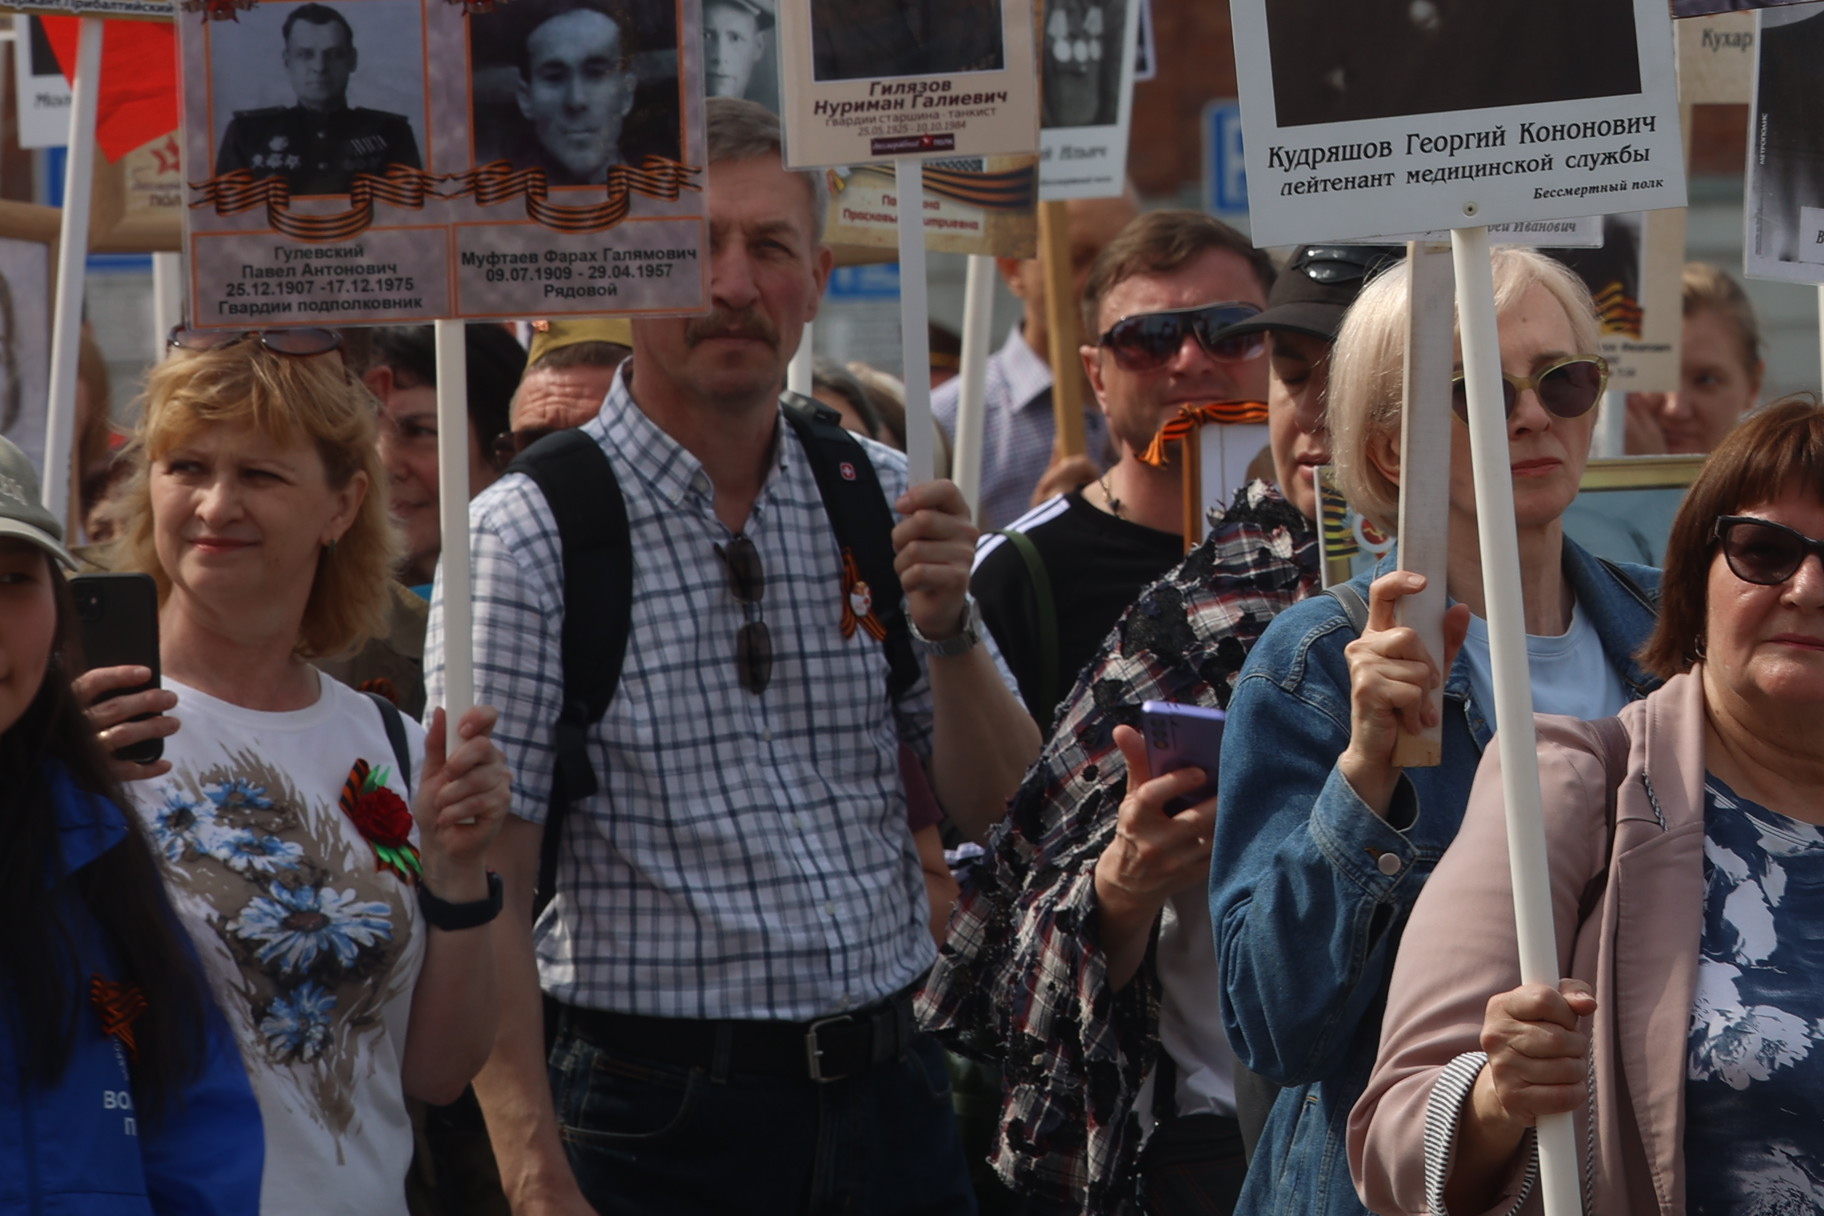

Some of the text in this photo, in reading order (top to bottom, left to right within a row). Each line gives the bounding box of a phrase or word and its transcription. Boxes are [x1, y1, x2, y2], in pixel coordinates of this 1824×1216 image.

[1702, 27, 1752, 52] Кухар
[869, 79, 953, 97] Гилязов
[813, 89, 1008, 118] Нуриман Галиевич
[825, 115, 877, 128] гвардии
[879, 111, 940, 126] старшина
[949, 106, 997, 119] танкист
[1266, 115, 1658, 172] Кудряшов Георгий Кононович
[1759, 112, 1768, 165] МЕТРОПОЛИС
[1280, 144, 1651, 197] лейтенант медицинской службы
[1532, 177, 1665, 201] Бессмертный полк
[274, 244, 364, 263] Гулевский
[461, 247, 697, 268] Муфтаев Фарах Галямович
[242, 263, 397, 280] Павел Антонович
[486, 267, 572, 282] 09.07.1909
[588, 263, 673, 280] 29.04.1957
[226, 281, 314, 297] 25.12.1907
[543, 283, 618, 300] Рядовой
[218, 296, 423, 316] Гвардии подполковник
[103, 1090, 134, 1110] ВО
